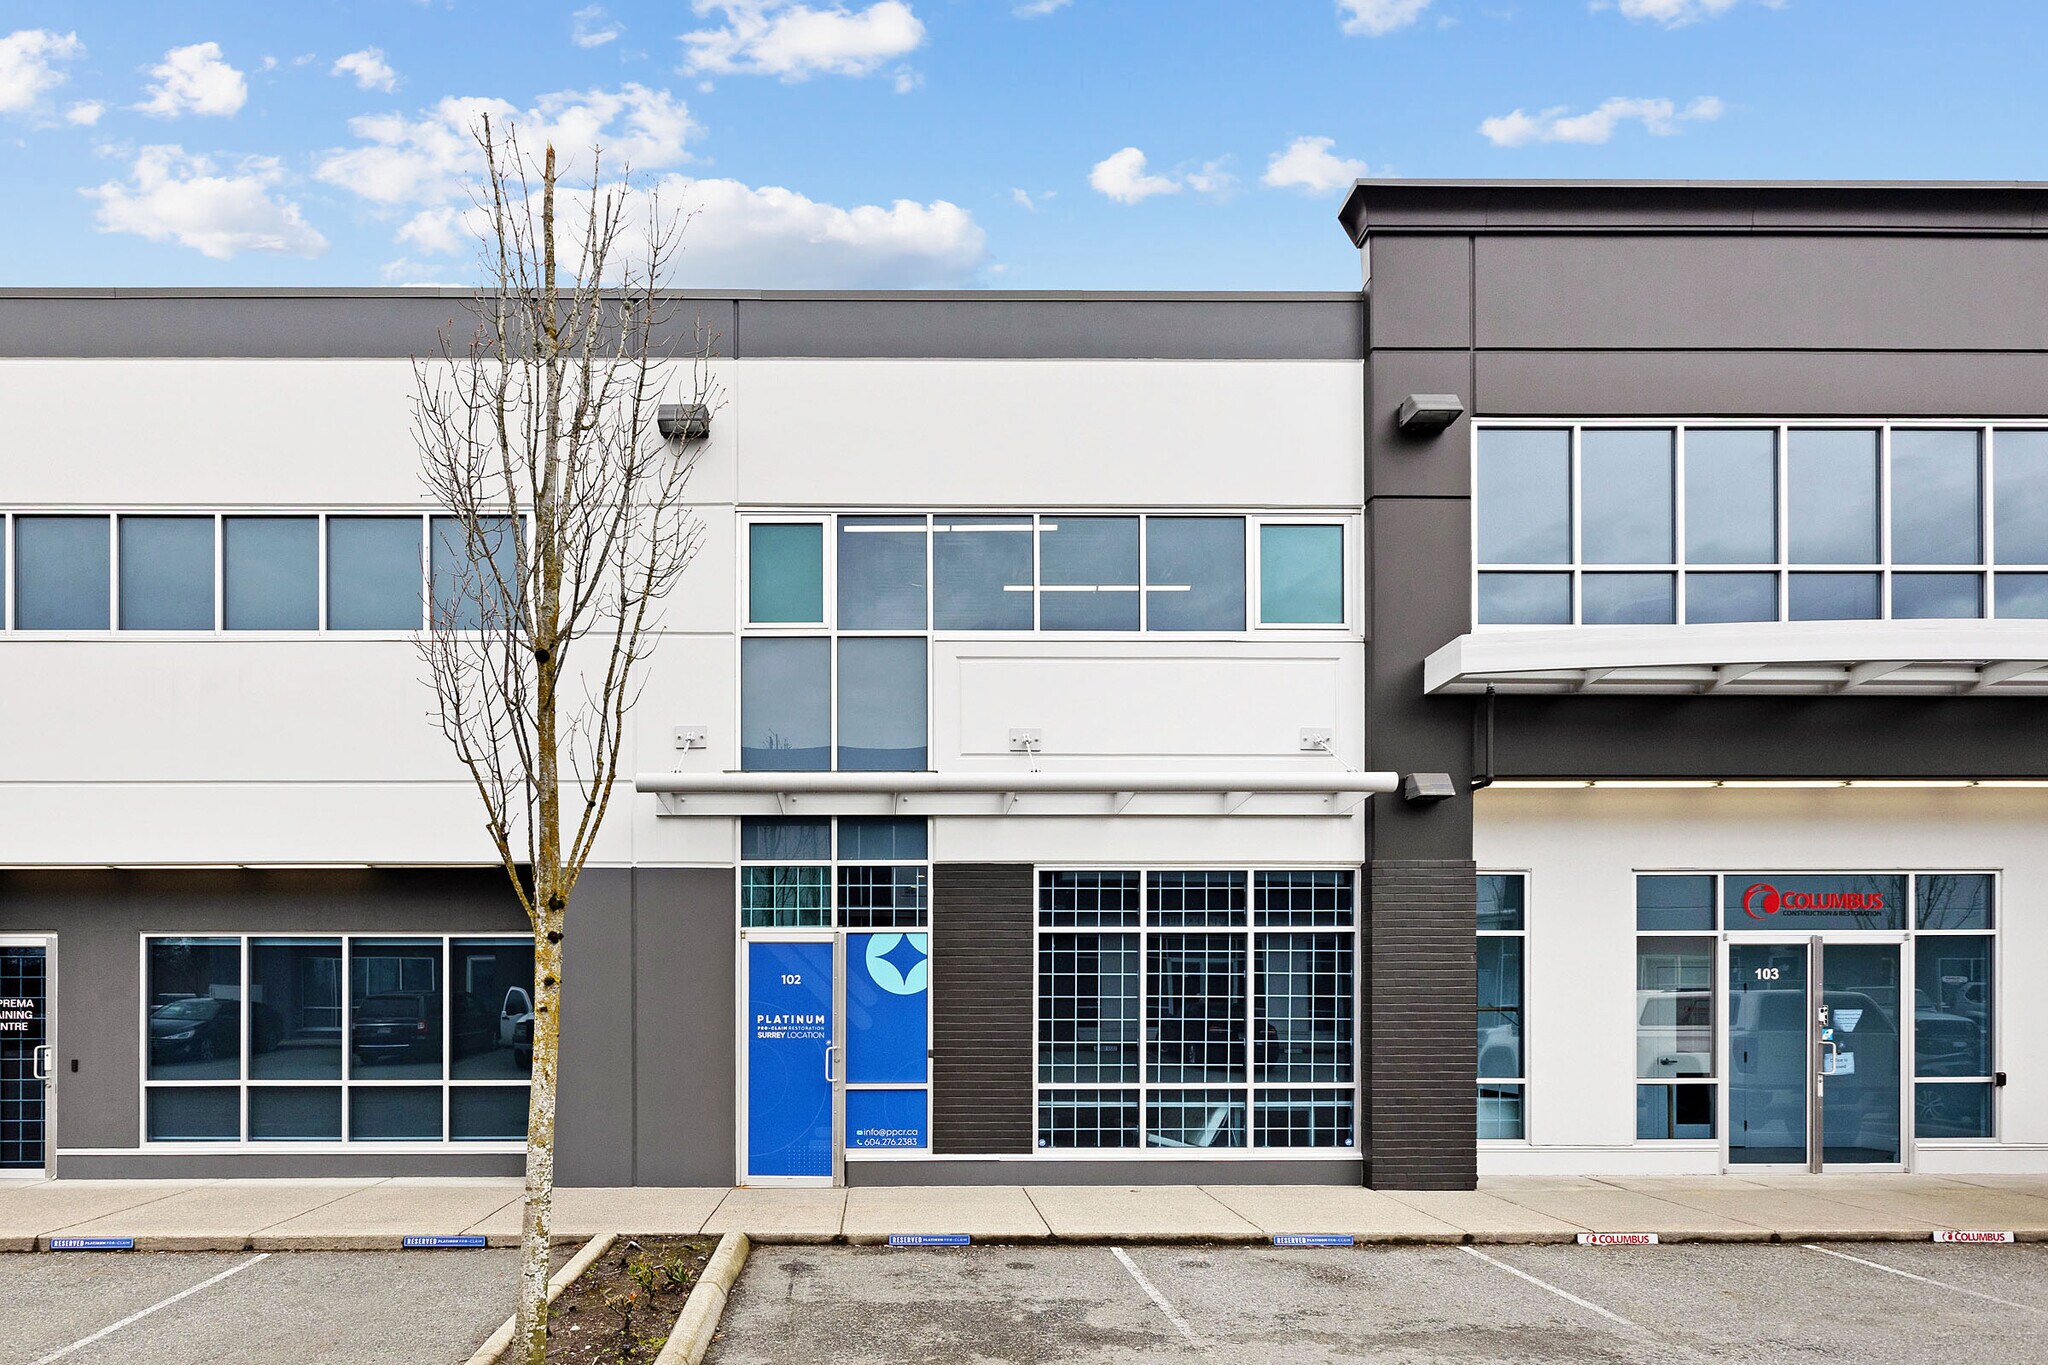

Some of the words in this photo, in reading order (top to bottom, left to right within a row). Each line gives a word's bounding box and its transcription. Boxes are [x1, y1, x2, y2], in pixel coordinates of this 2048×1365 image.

[1782, 891, 1884, 909] COLUMBUS
[1755, 967, 1779, 980] 103
[781, 974, 801, 984] 102
[0, 1010, 33, 1020] INING
[757, 1014, 825, 1024] PLATINUM
[757, 1031, 786, 1039] SURREY
[787, 1031, 825, 1039] LOCATION
[863, 1127, 919, 1137] info@ppcr.ca
[864, 1137, 918, 1146] 604.276.2383
[892, 1236, 922, 1244] RESERVED
[1598, 1234, 1650, 1244] COLUMBUS
[1954, 1231, 2006, 1242] COLUMBUS
